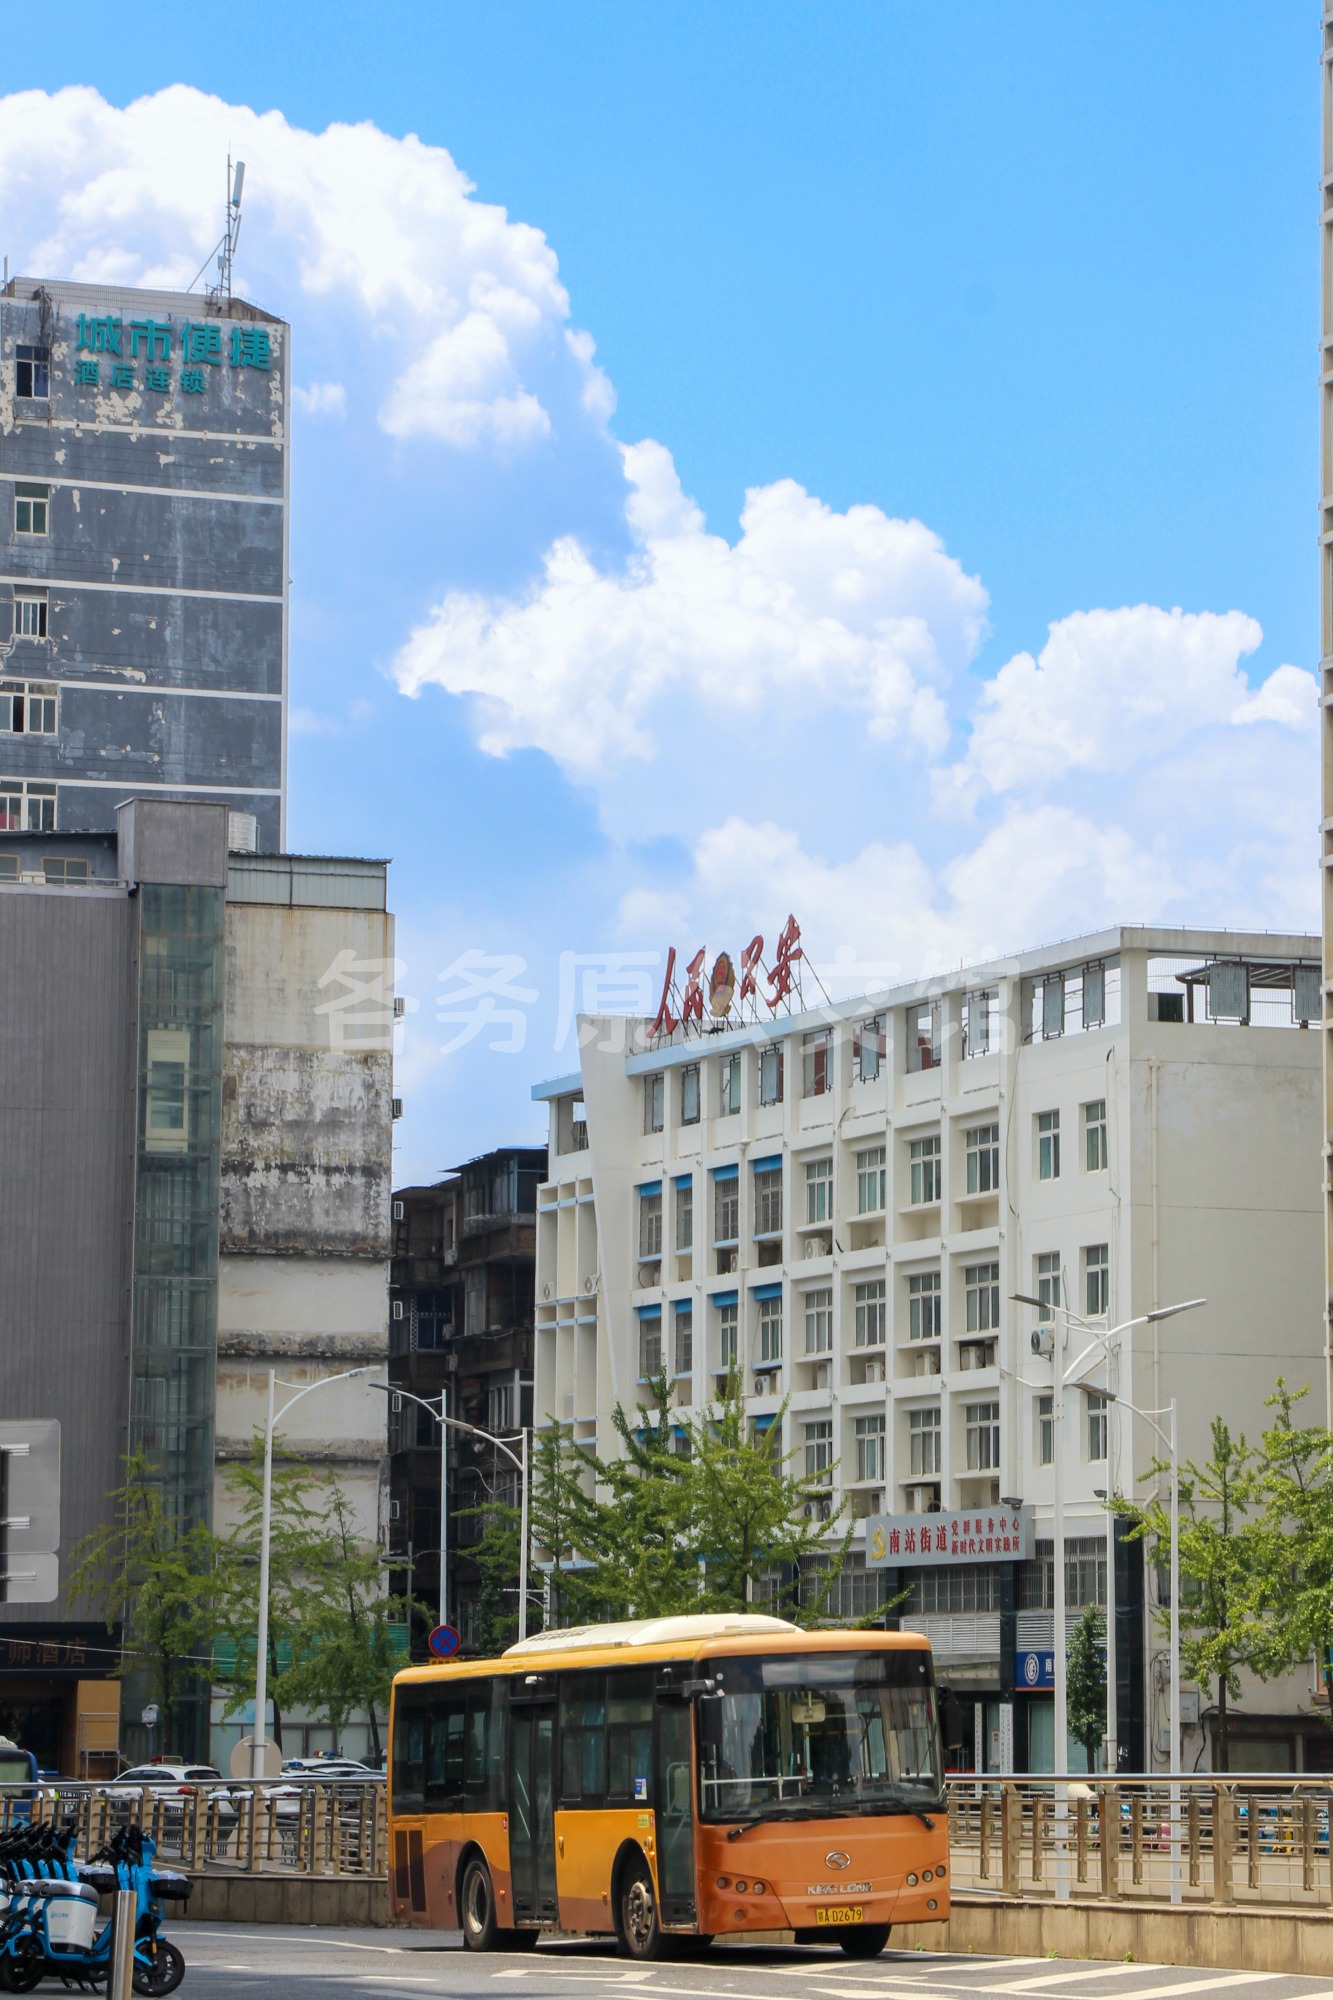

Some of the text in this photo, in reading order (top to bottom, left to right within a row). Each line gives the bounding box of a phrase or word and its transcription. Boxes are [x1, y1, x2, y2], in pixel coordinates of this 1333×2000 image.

[75, 312, 271, 371] 城市便捷
[74, 359, 205, 394] 酒店连锁
[889, 1523, 948, 1555] 南站街道
[951, 1516, 1020, 1536] 党群服务中心
[951, 1535, 1020, 1555] 新时代文明实践所
[0, 1638, 88, 1665] 师酒店
